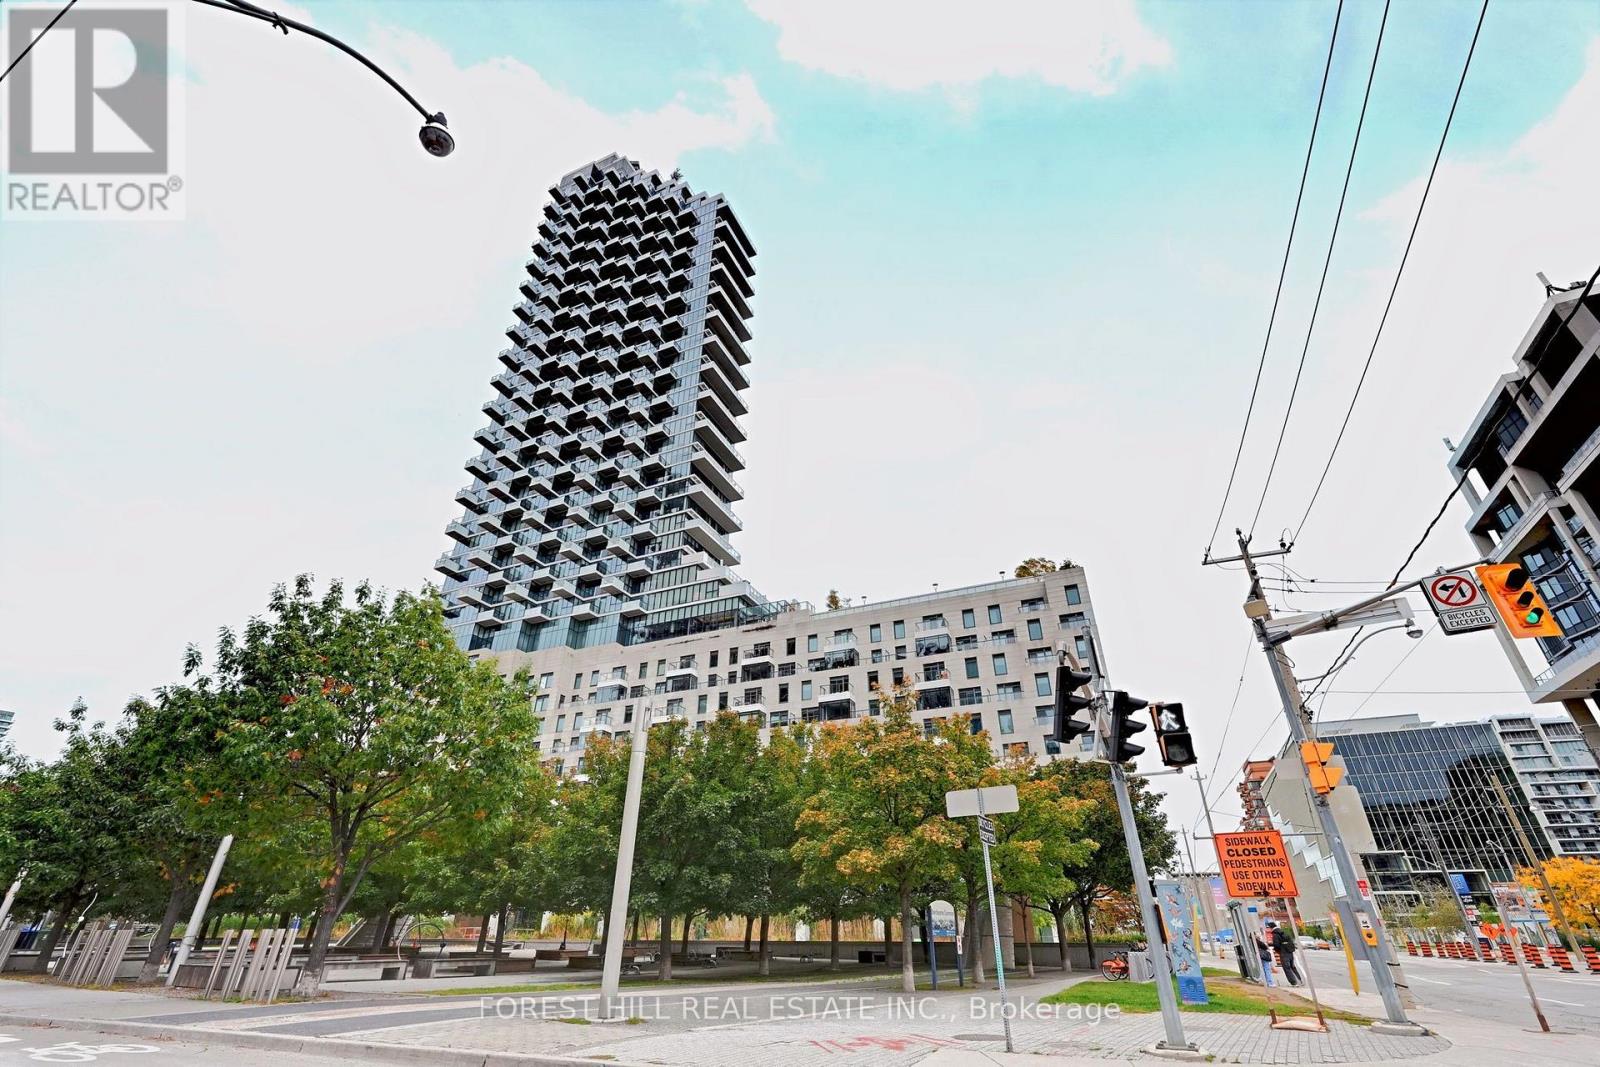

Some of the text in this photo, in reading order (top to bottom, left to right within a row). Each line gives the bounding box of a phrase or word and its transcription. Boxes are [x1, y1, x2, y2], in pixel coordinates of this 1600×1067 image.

[1447, 609, 1486, 620] BICYCLES
[1449, 616, 1491, 628] EXCEPTED
[1225, 836, 1272, 846] SIDEWALK
[1227, 847, 1277, 857] CLOSED
[1224, 858, 1286, 869] PEDESTRIANS
[1232, 870, 1284, 880] USE OTHER
[1237, 881, 1286, 892] SIDEWALK
